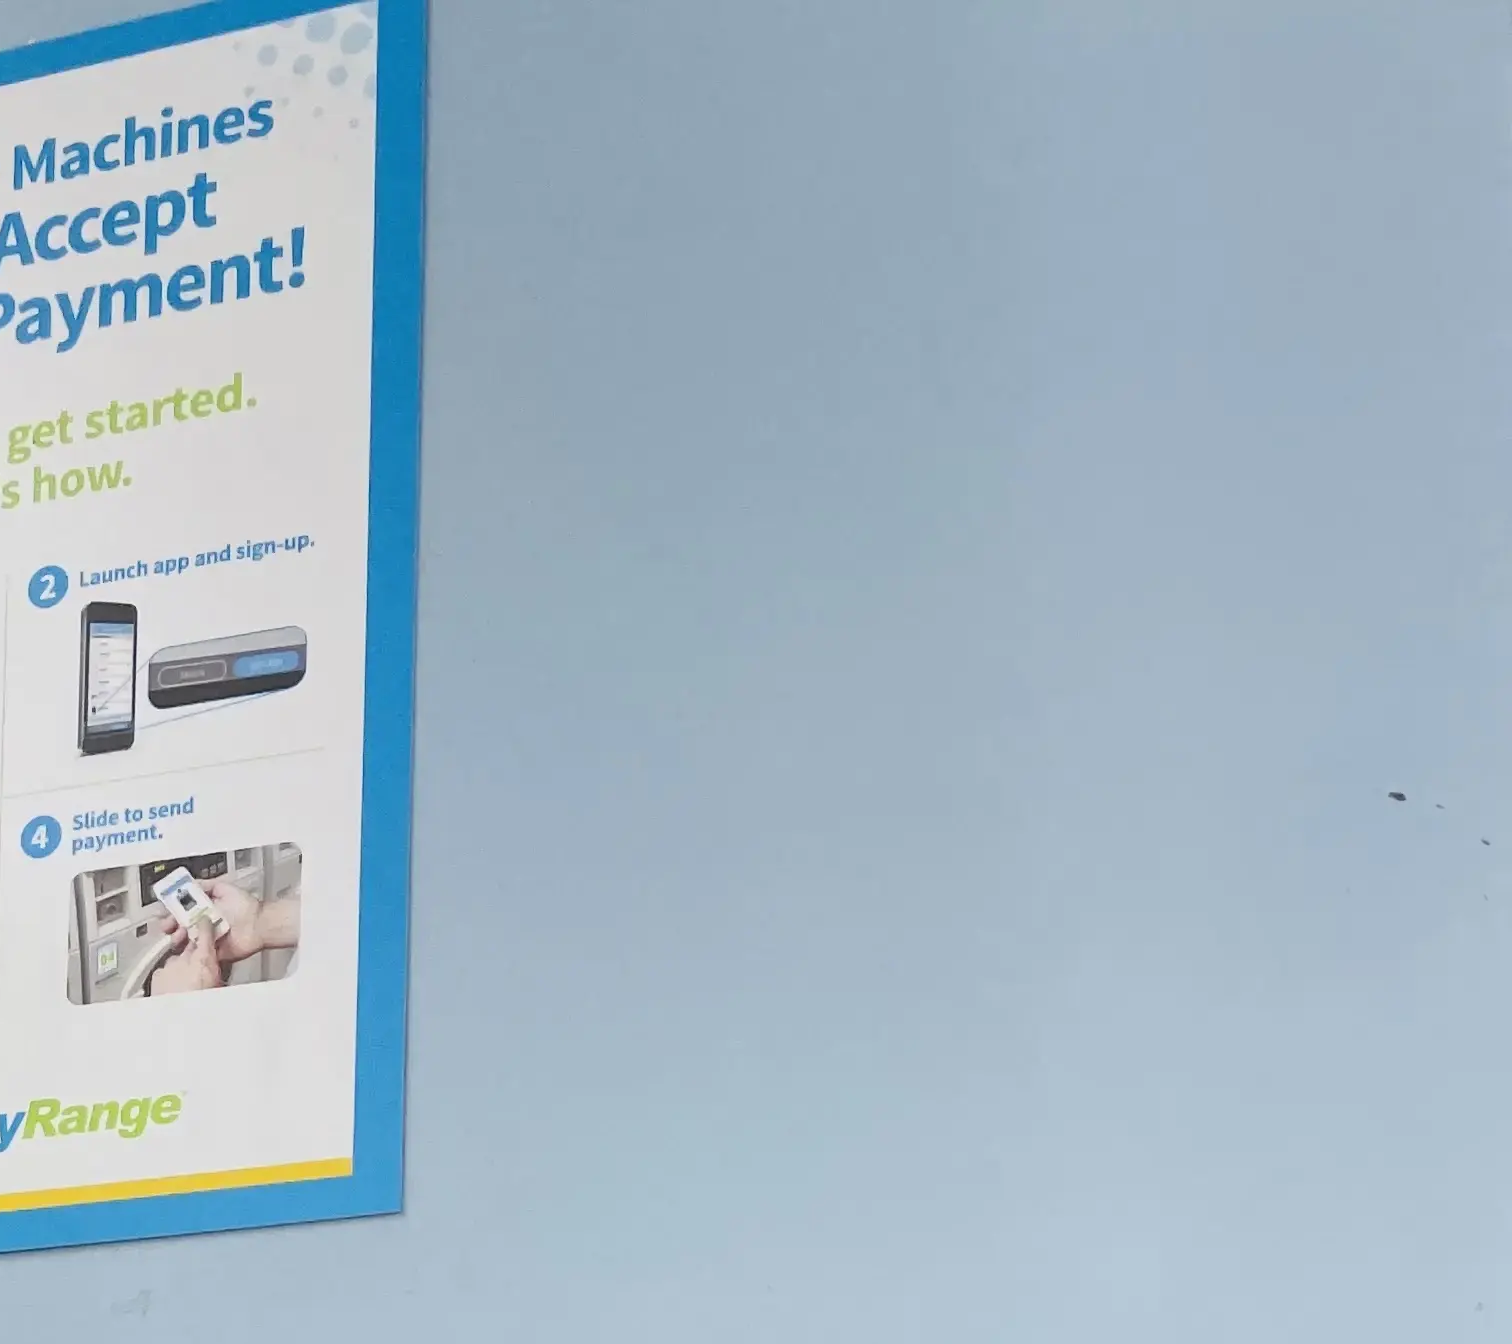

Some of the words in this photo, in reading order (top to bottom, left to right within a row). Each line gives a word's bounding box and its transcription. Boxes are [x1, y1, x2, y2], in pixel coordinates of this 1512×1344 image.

[11, 98, 275, 190] Machines
[7, 411, 74, 464] get
[84, 372, 258, 441] started.
[32, 456, 133, 505] how.
[79, 561, 148, 587] Launch
[153, 557, 189, 576] app
[195, 544, 232, 567] and
[236, 534, 315, 561] sign-up.
[39, 574, 57, 600] 2
[72, 809, 119, 831] Slide
[124, 807, 143, 824] to
[148, 797, 195, 819] send
[30, 824, 49, 849] 4
[71, 823, 164, 855] payment.
